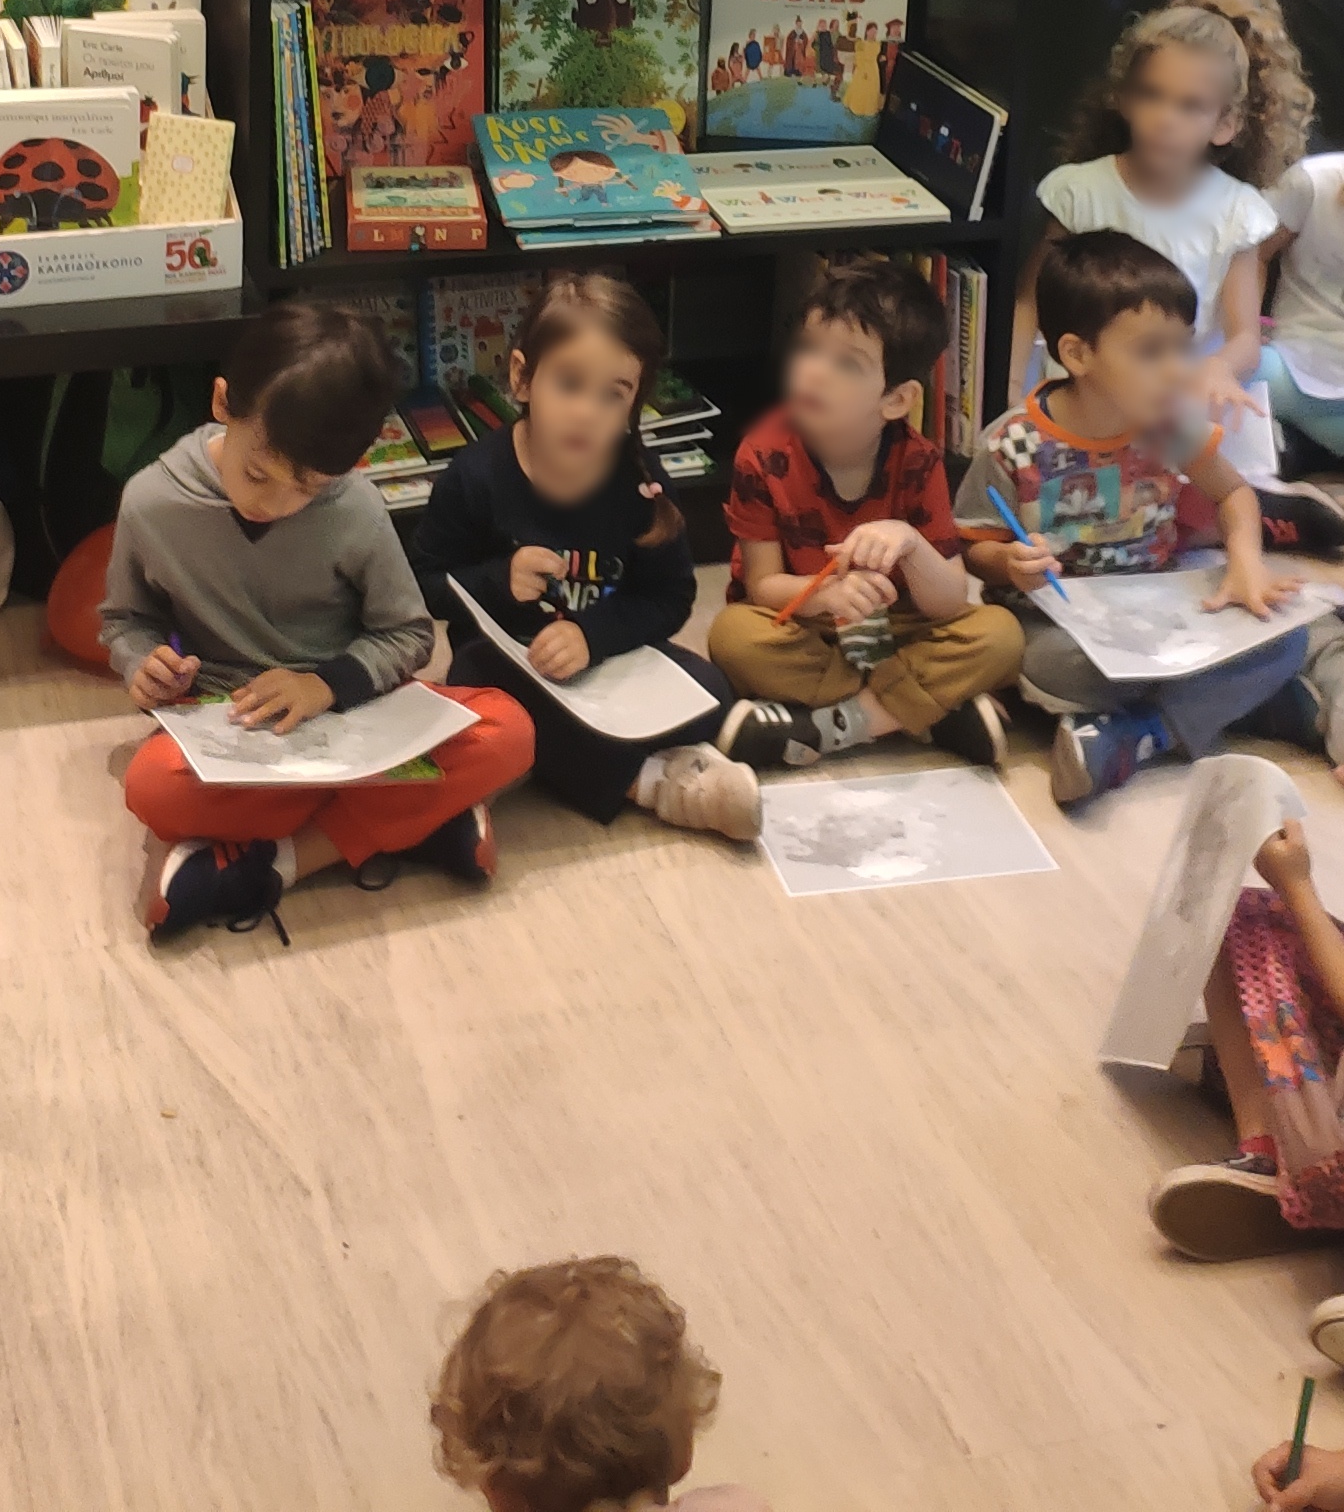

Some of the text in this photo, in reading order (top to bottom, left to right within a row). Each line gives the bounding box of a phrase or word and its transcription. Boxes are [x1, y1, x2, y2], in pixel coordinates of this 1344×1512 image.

[82, 39, 123, 52] Eric Carle
[82, 52, 96, 64] Οι
[486, 115, 569, 144] ROSA
[492, 131, 590, 165] DRAWS
[37, 256, 143, 275] ΚΑΛΕΙΔΟΣΚΟΠΙΟ
[166, 237, 212, 272] 50
